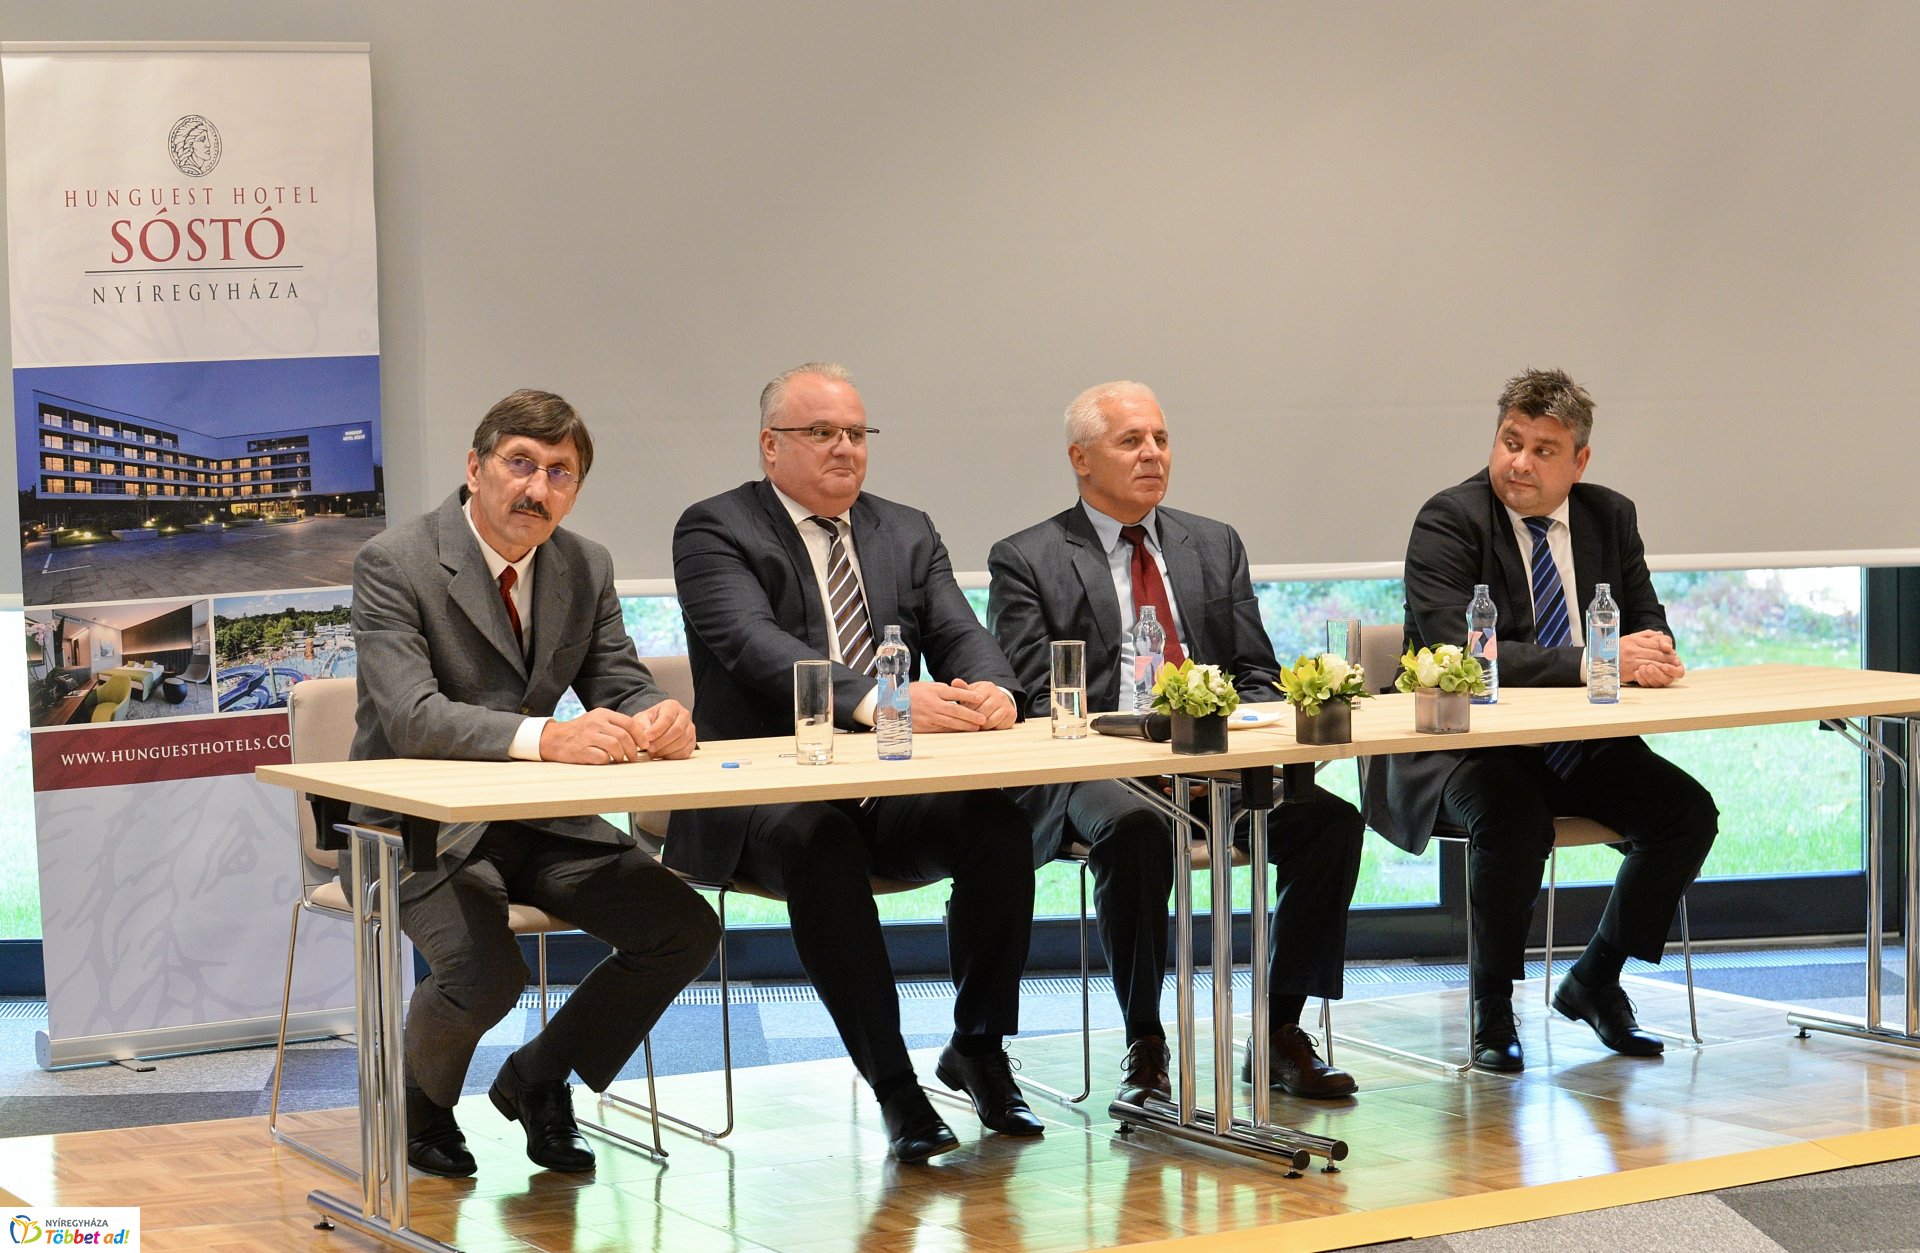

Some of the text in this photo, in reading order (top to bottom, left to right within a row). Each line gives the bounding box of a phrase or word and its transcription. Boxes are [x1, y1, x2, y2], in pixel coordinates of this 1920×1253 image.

[64, 186, 319, 208] HUNGUEST HOTEL
[110, 205, 286, 264] SÓSTÓ
[92, 278, 299, 304] NYÍREGYHÁZA
[60, 733, 291, 767] WWW.HUNGUESTHOTELS.CO
